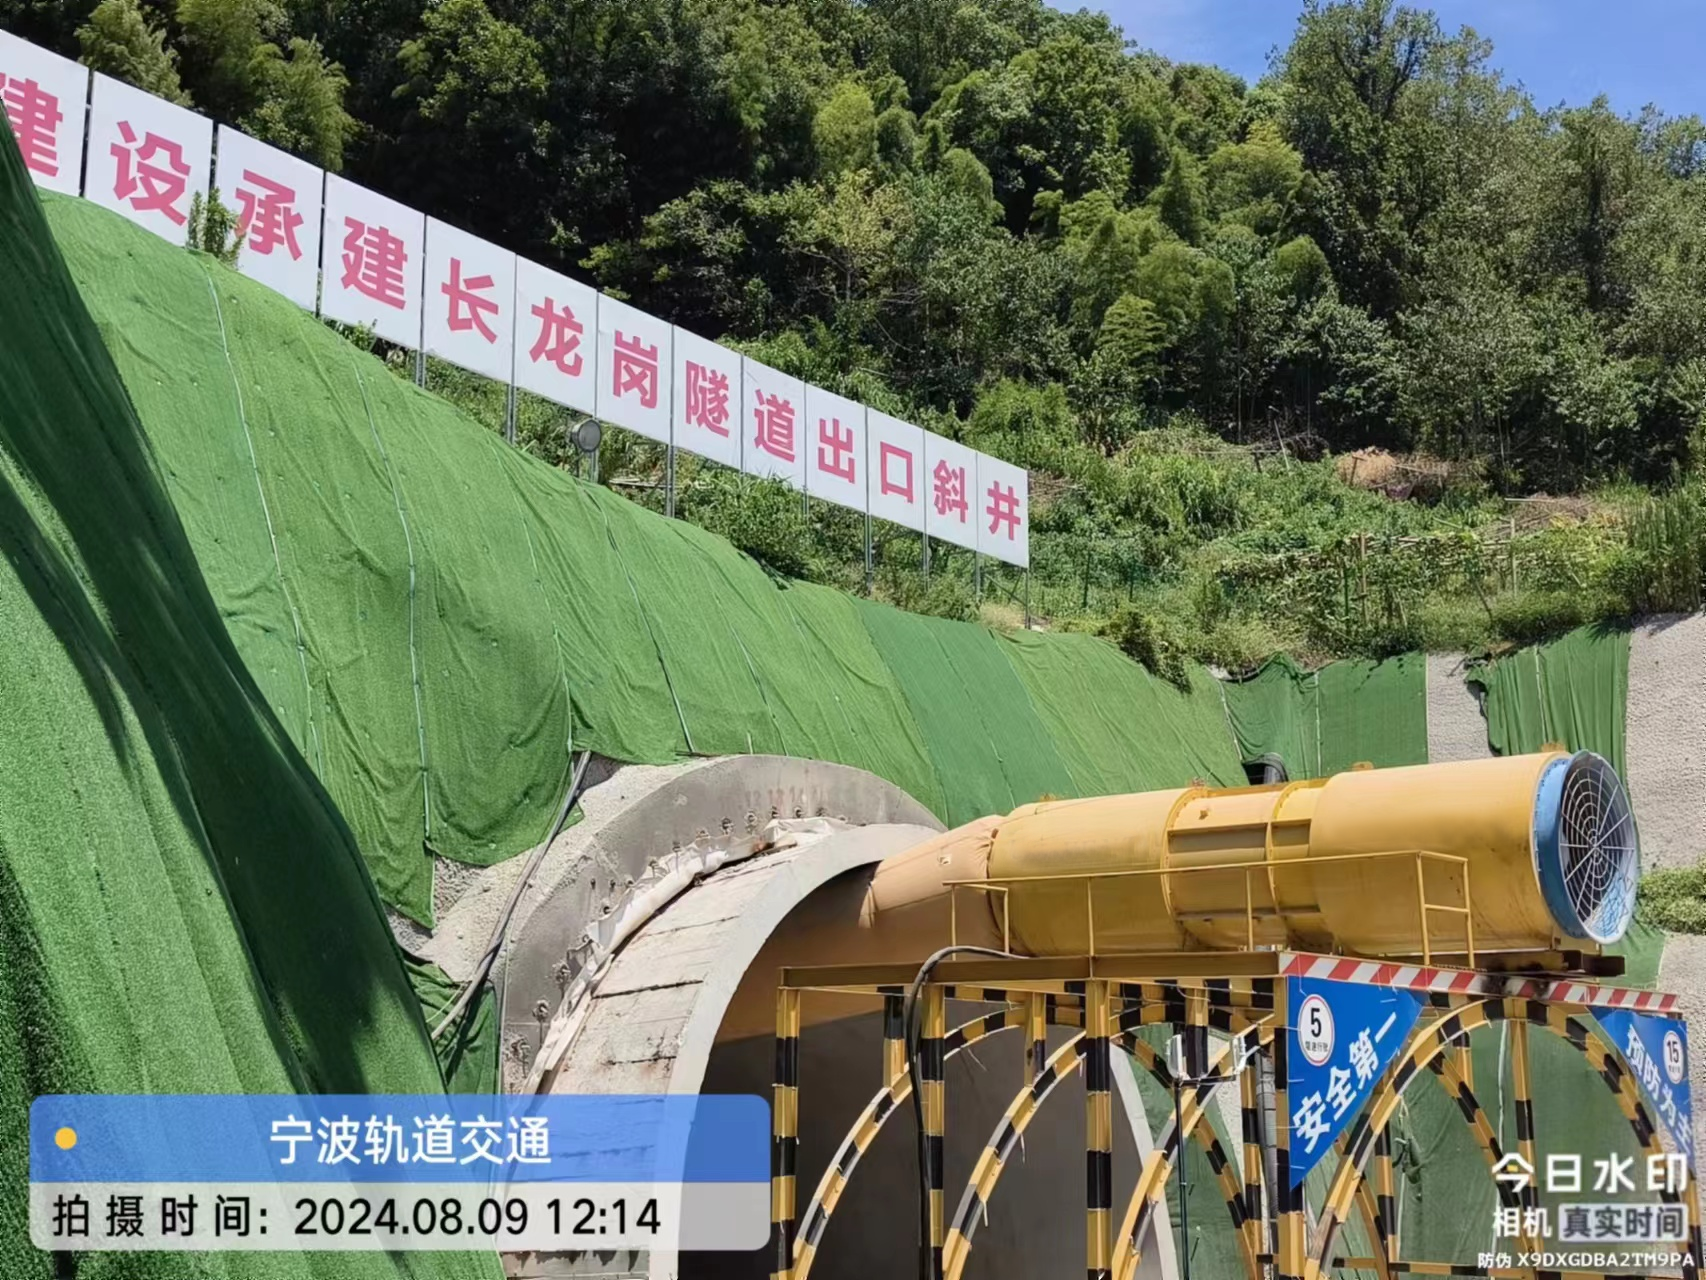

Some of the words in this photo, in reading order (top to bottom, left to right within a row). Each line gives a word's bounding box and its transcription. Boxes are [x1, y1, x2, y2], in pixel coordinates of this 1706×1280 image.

[0, 72, 1021, 541] 建设承建长龙岗隧道出口斜井
[1292, 1011, 1397, 1154] 安全第一
[1311, 1007, 1321, 1037] 5
[1666, 1041, 1679, 1063] 15
[1625, 1023, 1692, 1156] 预防为主
